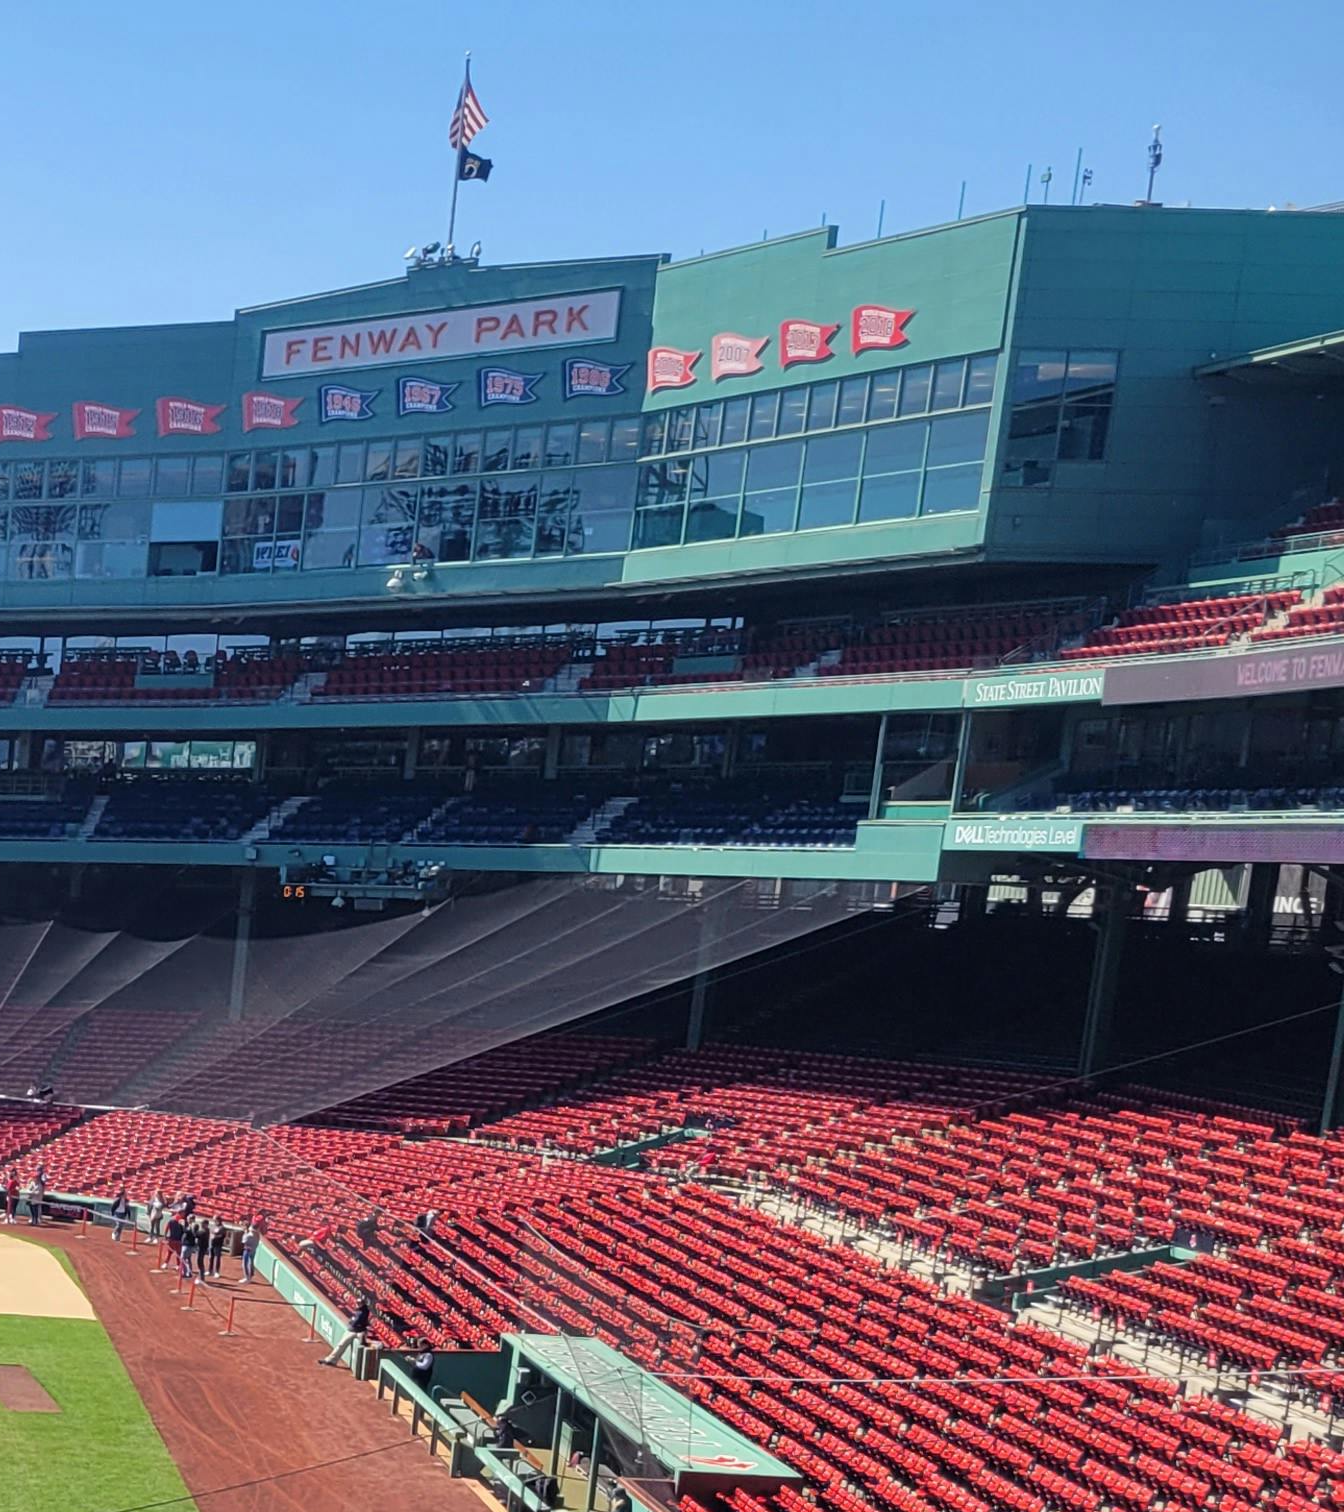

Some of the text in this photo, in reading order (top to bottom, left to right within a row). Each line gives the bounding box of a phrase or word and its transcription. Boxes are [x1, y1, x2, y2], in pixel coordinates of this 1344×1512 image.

[284, 304, 590, 365] FENWAY PARK
[719, 345, 750, 362] 2007
[1237, 660, 1289, 686] WELCOME
[1292, 658, 1307, 680] TO
[976, 677, 1102, 703] STATE STREET PAVILION
[955, 826, 1077, 847] DELL Technologies Level
